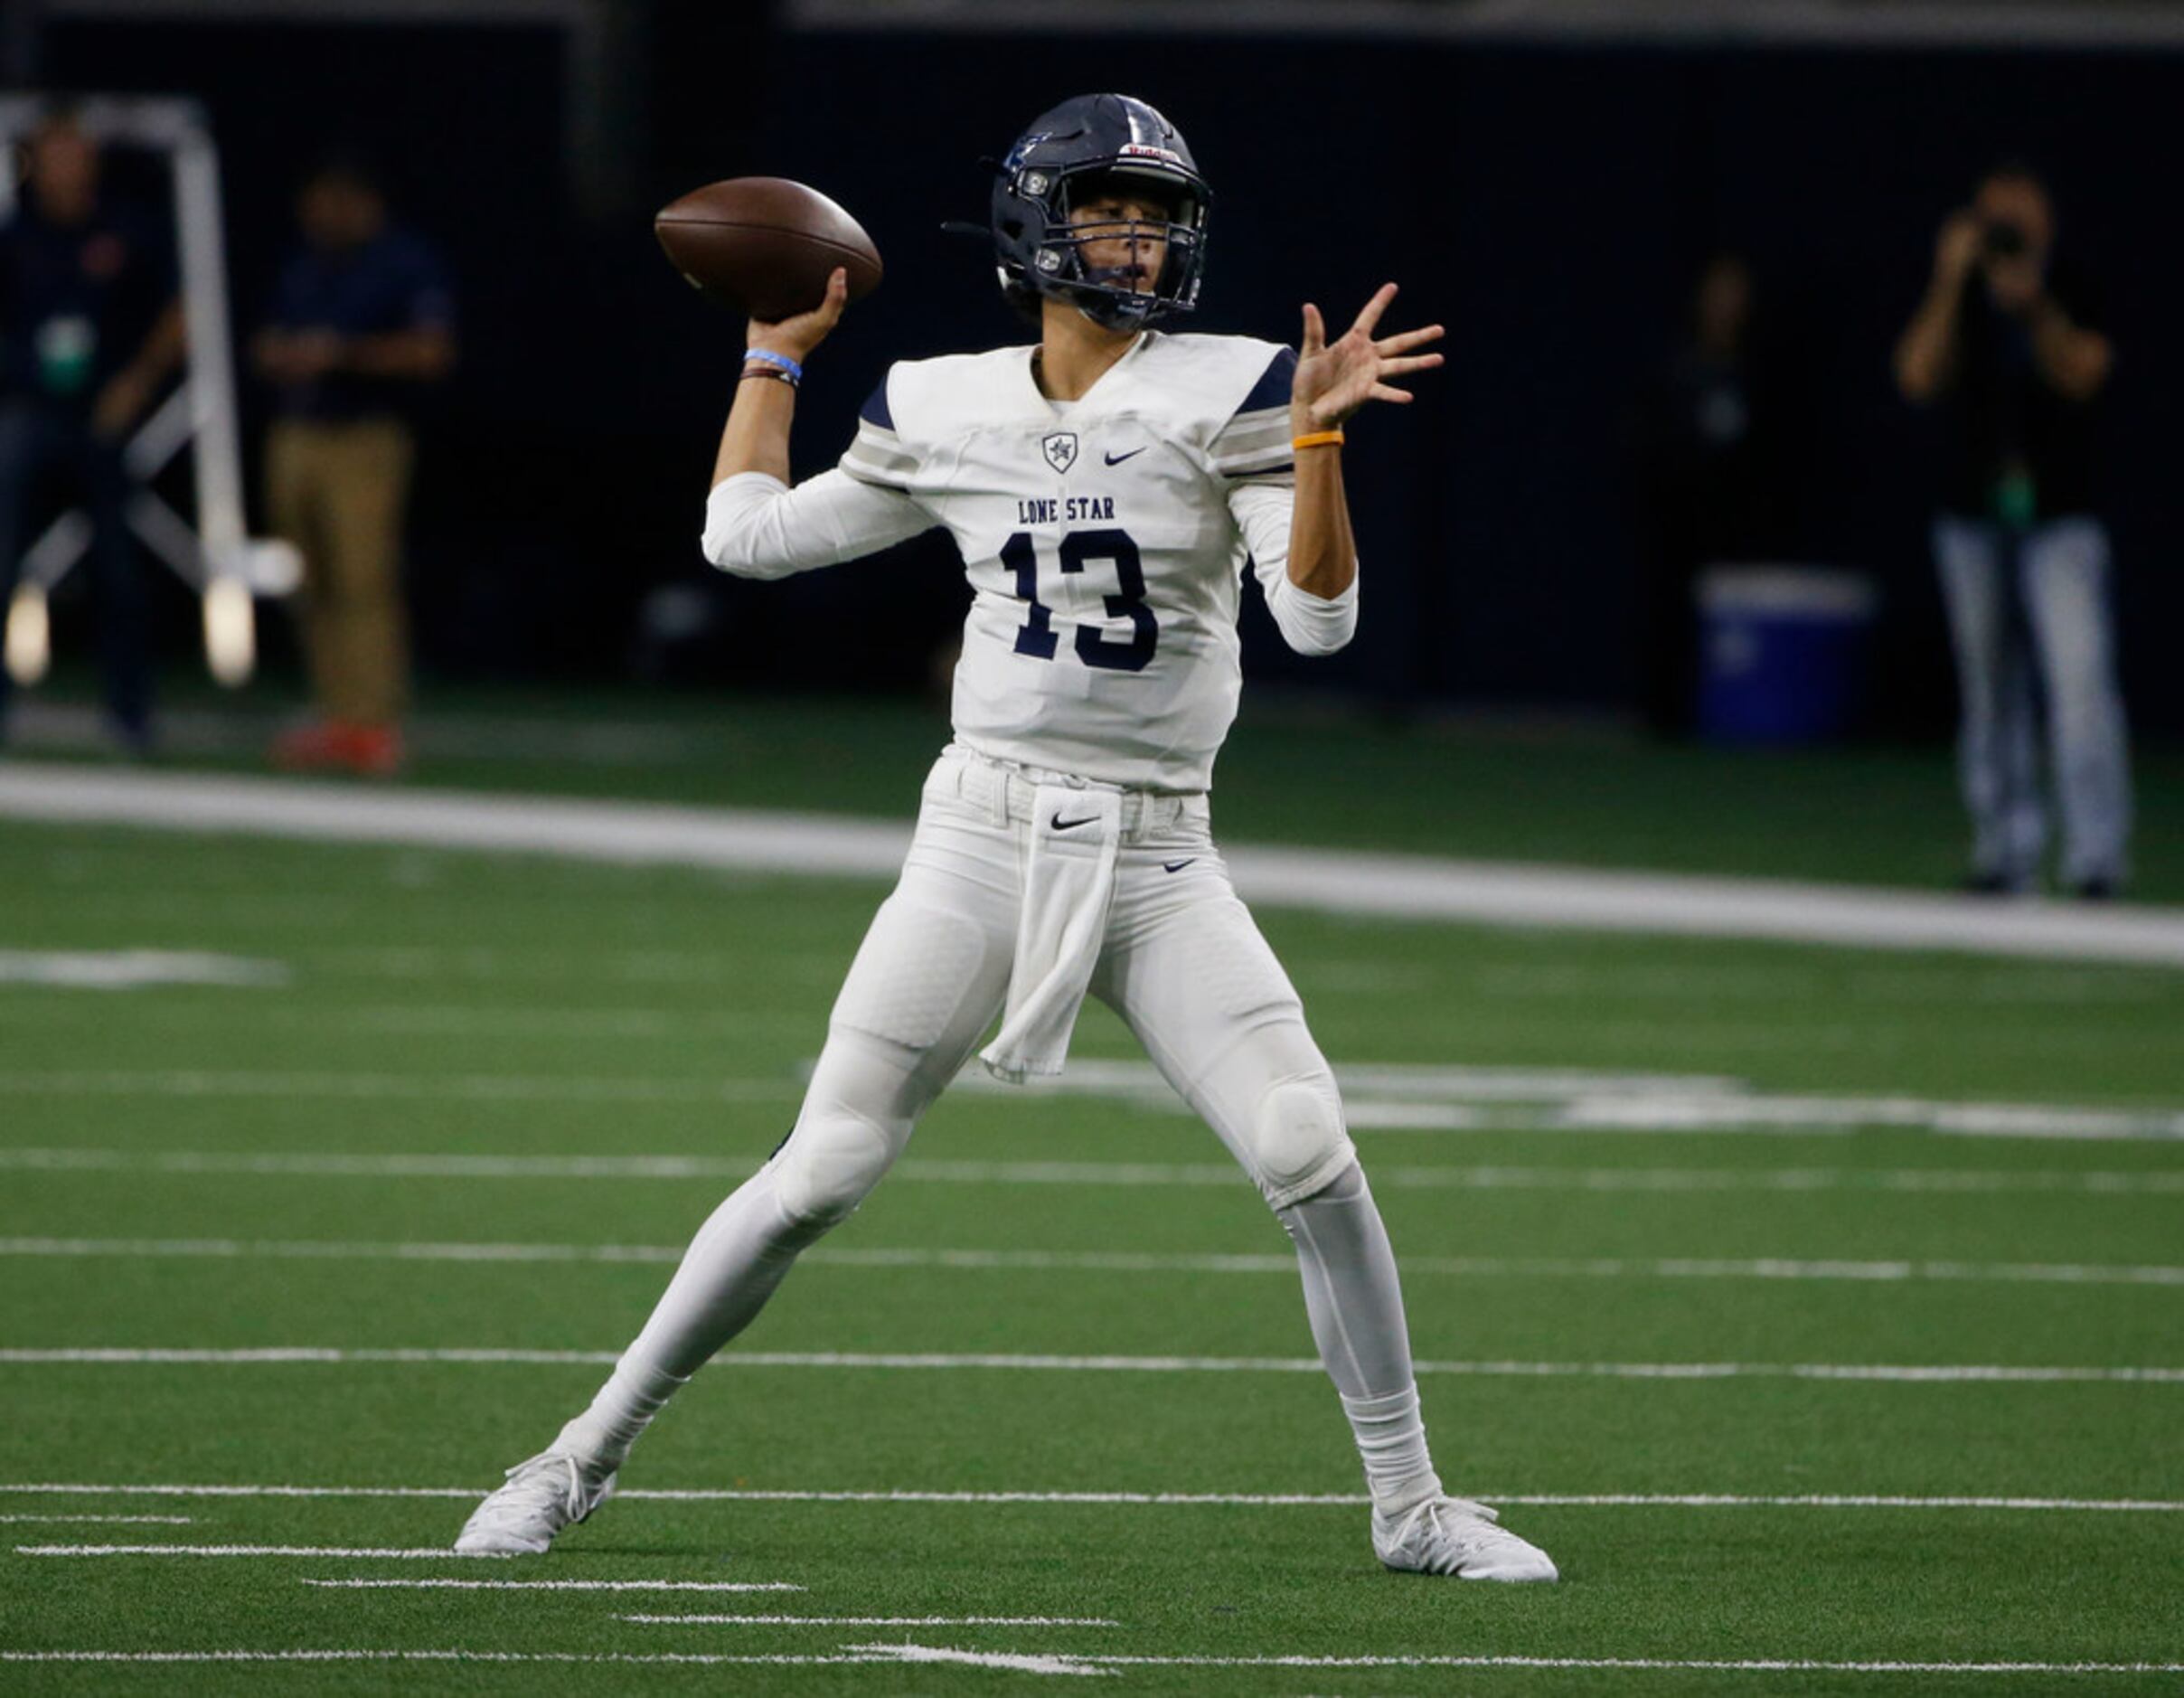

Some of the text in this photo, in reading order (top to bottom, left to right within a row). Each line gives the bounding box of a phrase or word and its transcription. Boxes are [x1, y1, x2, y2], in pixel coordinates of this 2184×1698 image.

[1129, 145, 1176, 160] Ridd
[1019, 497, 1115, 524] LONE STAR
[1000, 528, 1159, 672] 13
